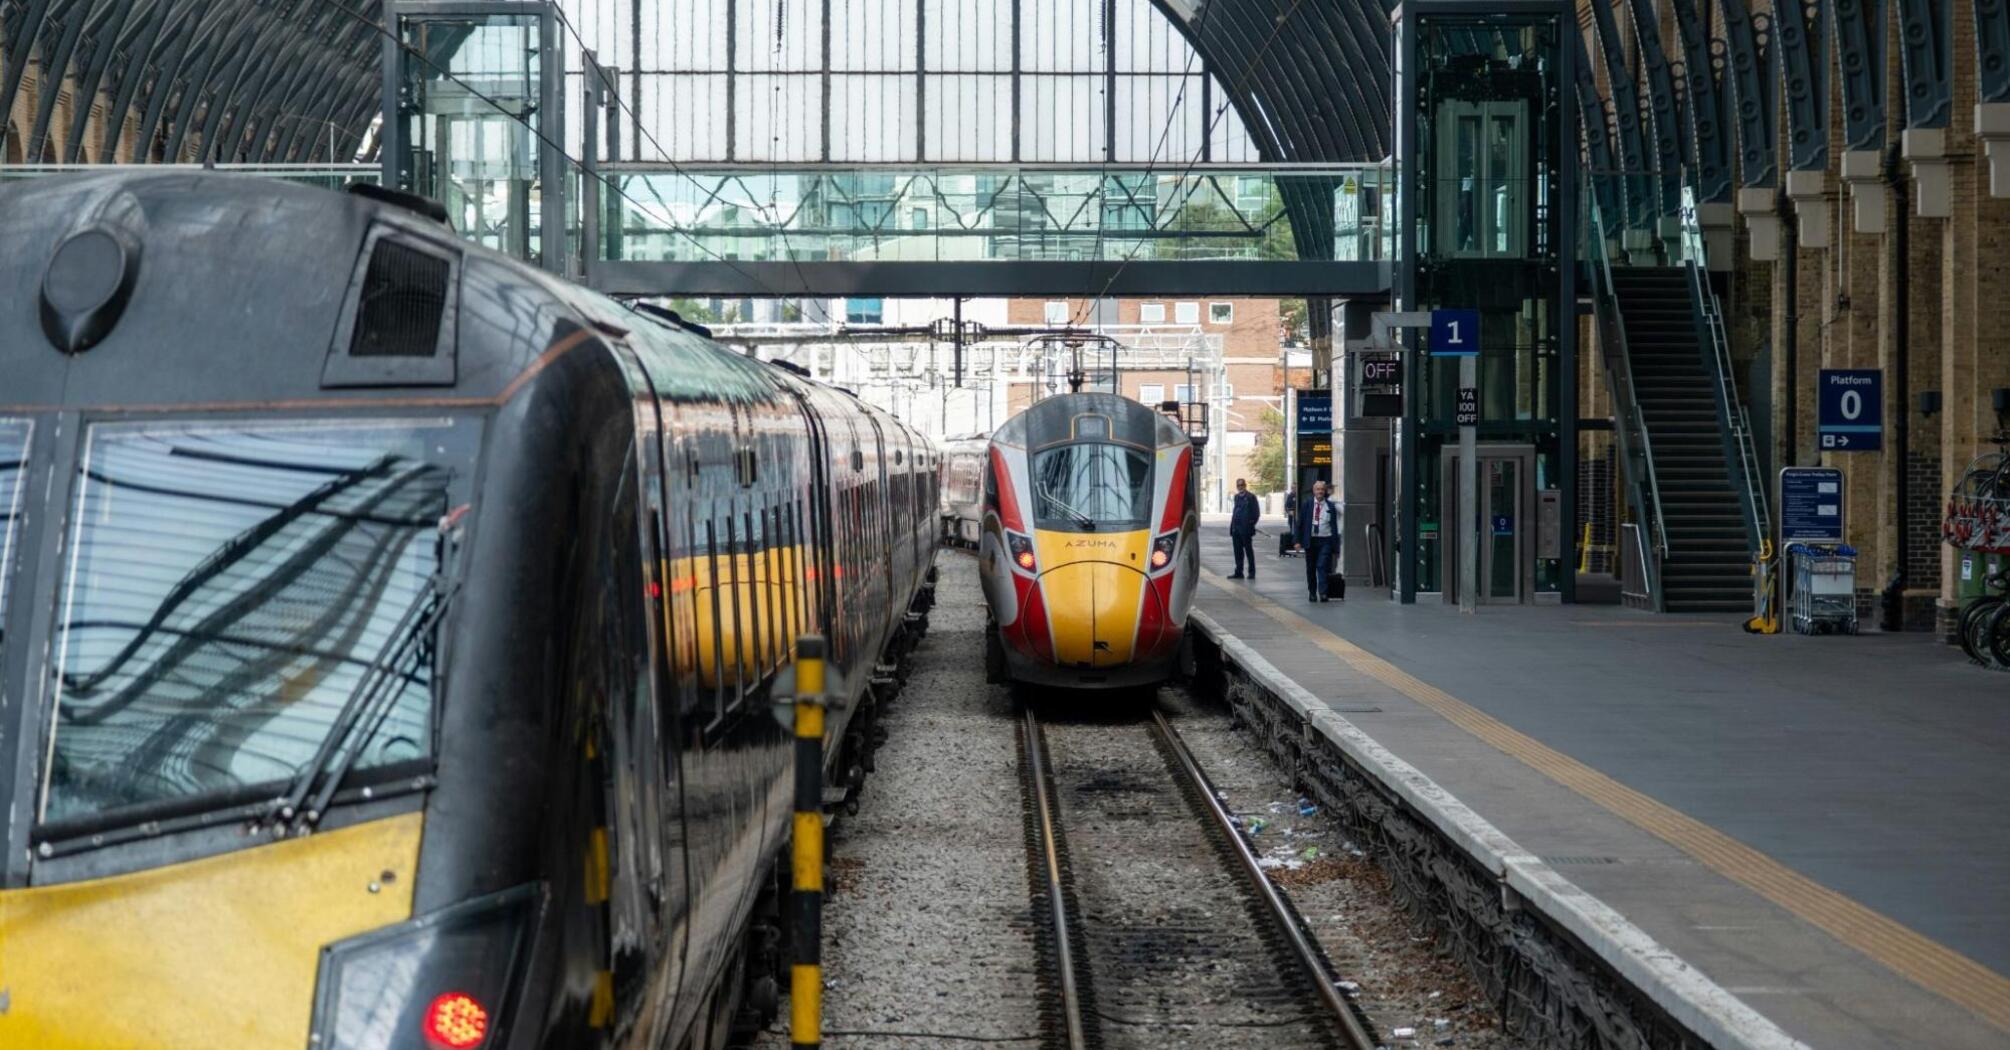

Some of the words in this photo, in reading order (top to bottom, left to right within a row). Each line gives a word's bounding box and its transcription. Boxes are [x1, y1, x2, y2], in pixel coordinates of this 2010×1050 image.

[1447, 320, 1463, 344] 1
[1365, 362, 1396, 379] OFF
[1831, 375, 1872, 385] Platform
[1460, 391, 1474, 400] YA
[1840, 389, 1862, 420] 0
[1457, 413, 1477, 424] OFF
